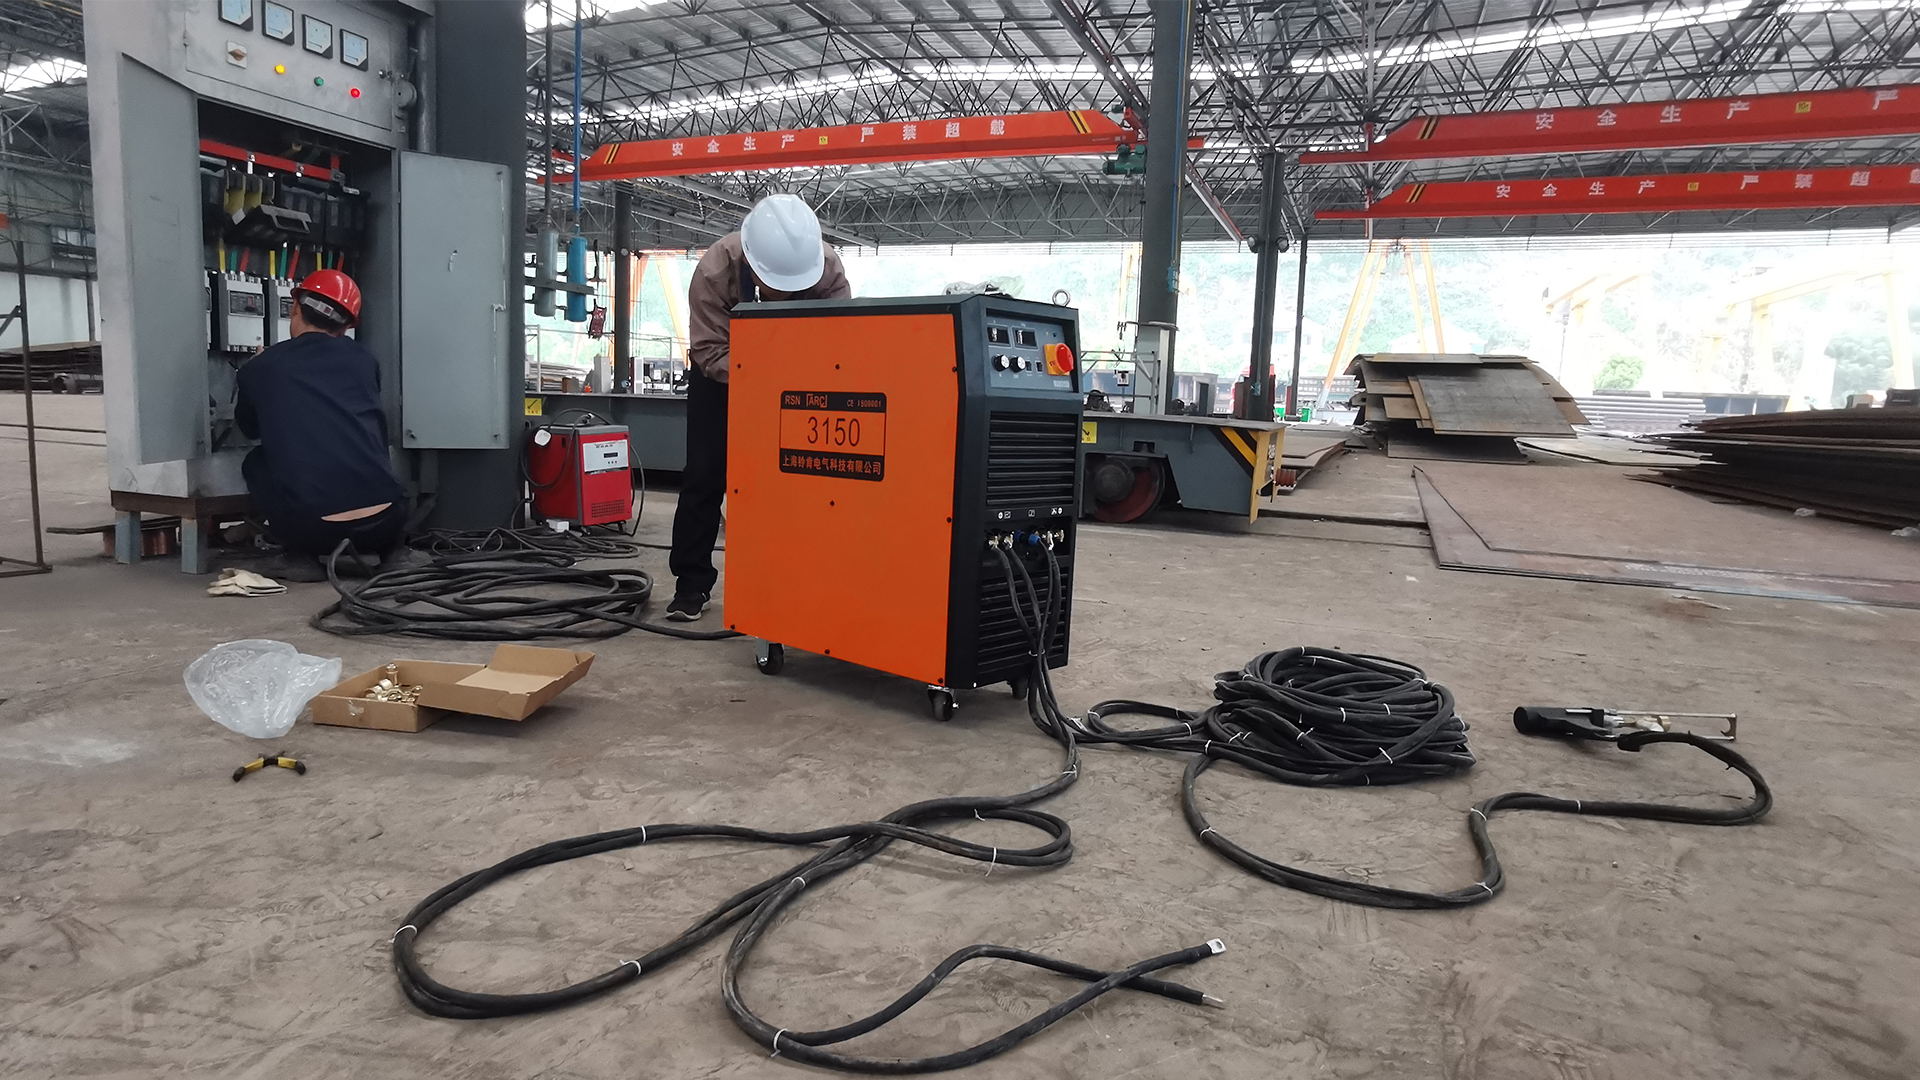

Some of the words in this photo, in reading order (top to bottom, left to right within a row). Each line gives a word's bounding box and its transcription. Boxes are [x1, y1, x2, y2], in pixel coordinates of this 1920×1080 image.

[1536, 101, 1750, 130] 安全生产
[672, 134, 794, 156] 安全生产
[861, 119, 1005, 143] 严禁超载
[1496, 179, 1655, 198] 安全生产
[785, 395, 800, 405] RSN
[807, 416, 860, 447] 3150
